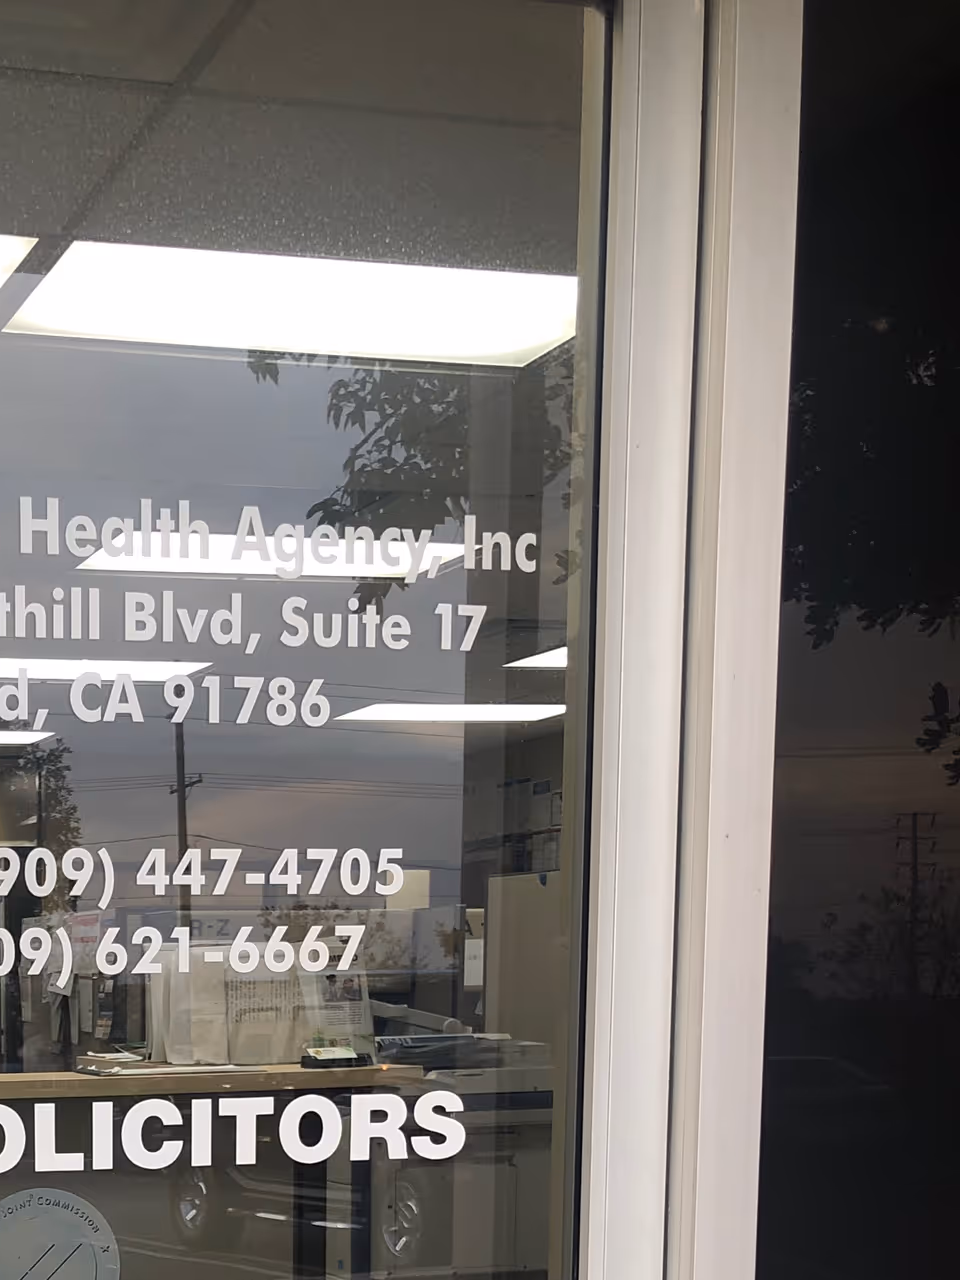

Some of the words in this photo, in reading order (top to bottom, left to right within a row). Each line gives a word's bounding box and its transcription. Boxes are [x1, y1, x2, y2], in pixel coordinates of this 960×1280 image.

[18, 496, 210, 561] Health
[232, 506, 442, 583] Agency,
[464, 515, 537, 573] Inc
[125, 590, 261, 654] Blvd,
[280, 596, 412, 650] Suite
[435, 603, 487, 652] 17
[70, 671, 144, 724] CA
[165, 674, 331, 728] 91786
[137, 848, 404, 896] 447-4705
[96, 925, 366, 976] 621-6667
